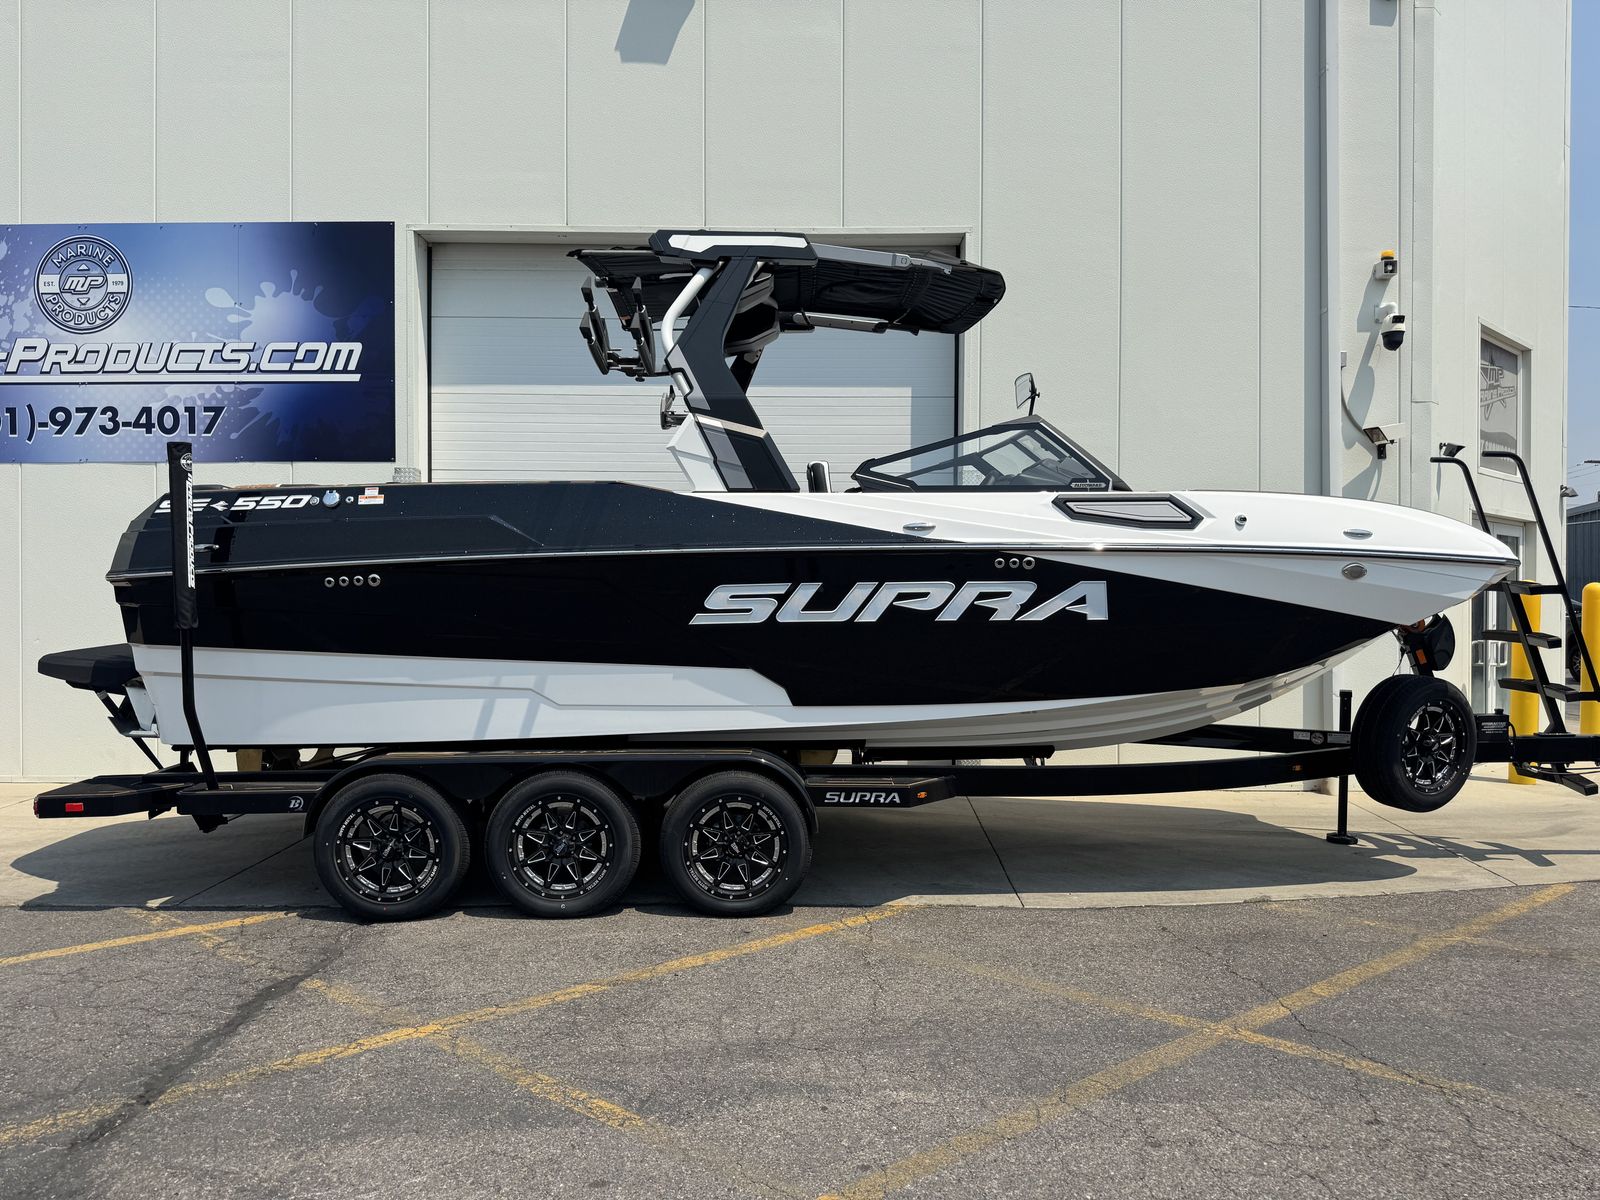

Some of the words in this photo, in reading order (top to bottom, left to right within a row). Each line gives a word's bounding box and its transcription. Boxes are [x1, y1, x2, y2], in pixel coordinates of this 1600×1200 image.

[51, 244, 115, 268] MARINE
[46, 294, 121, 325] PRODUCTS
[0, 403, 226, 444] 1)-973-4017
[230, 494, 313, 511] 550
[689, 580, 1108, 624] SUPRA
[824, 791, 901, 804] SUPRA
